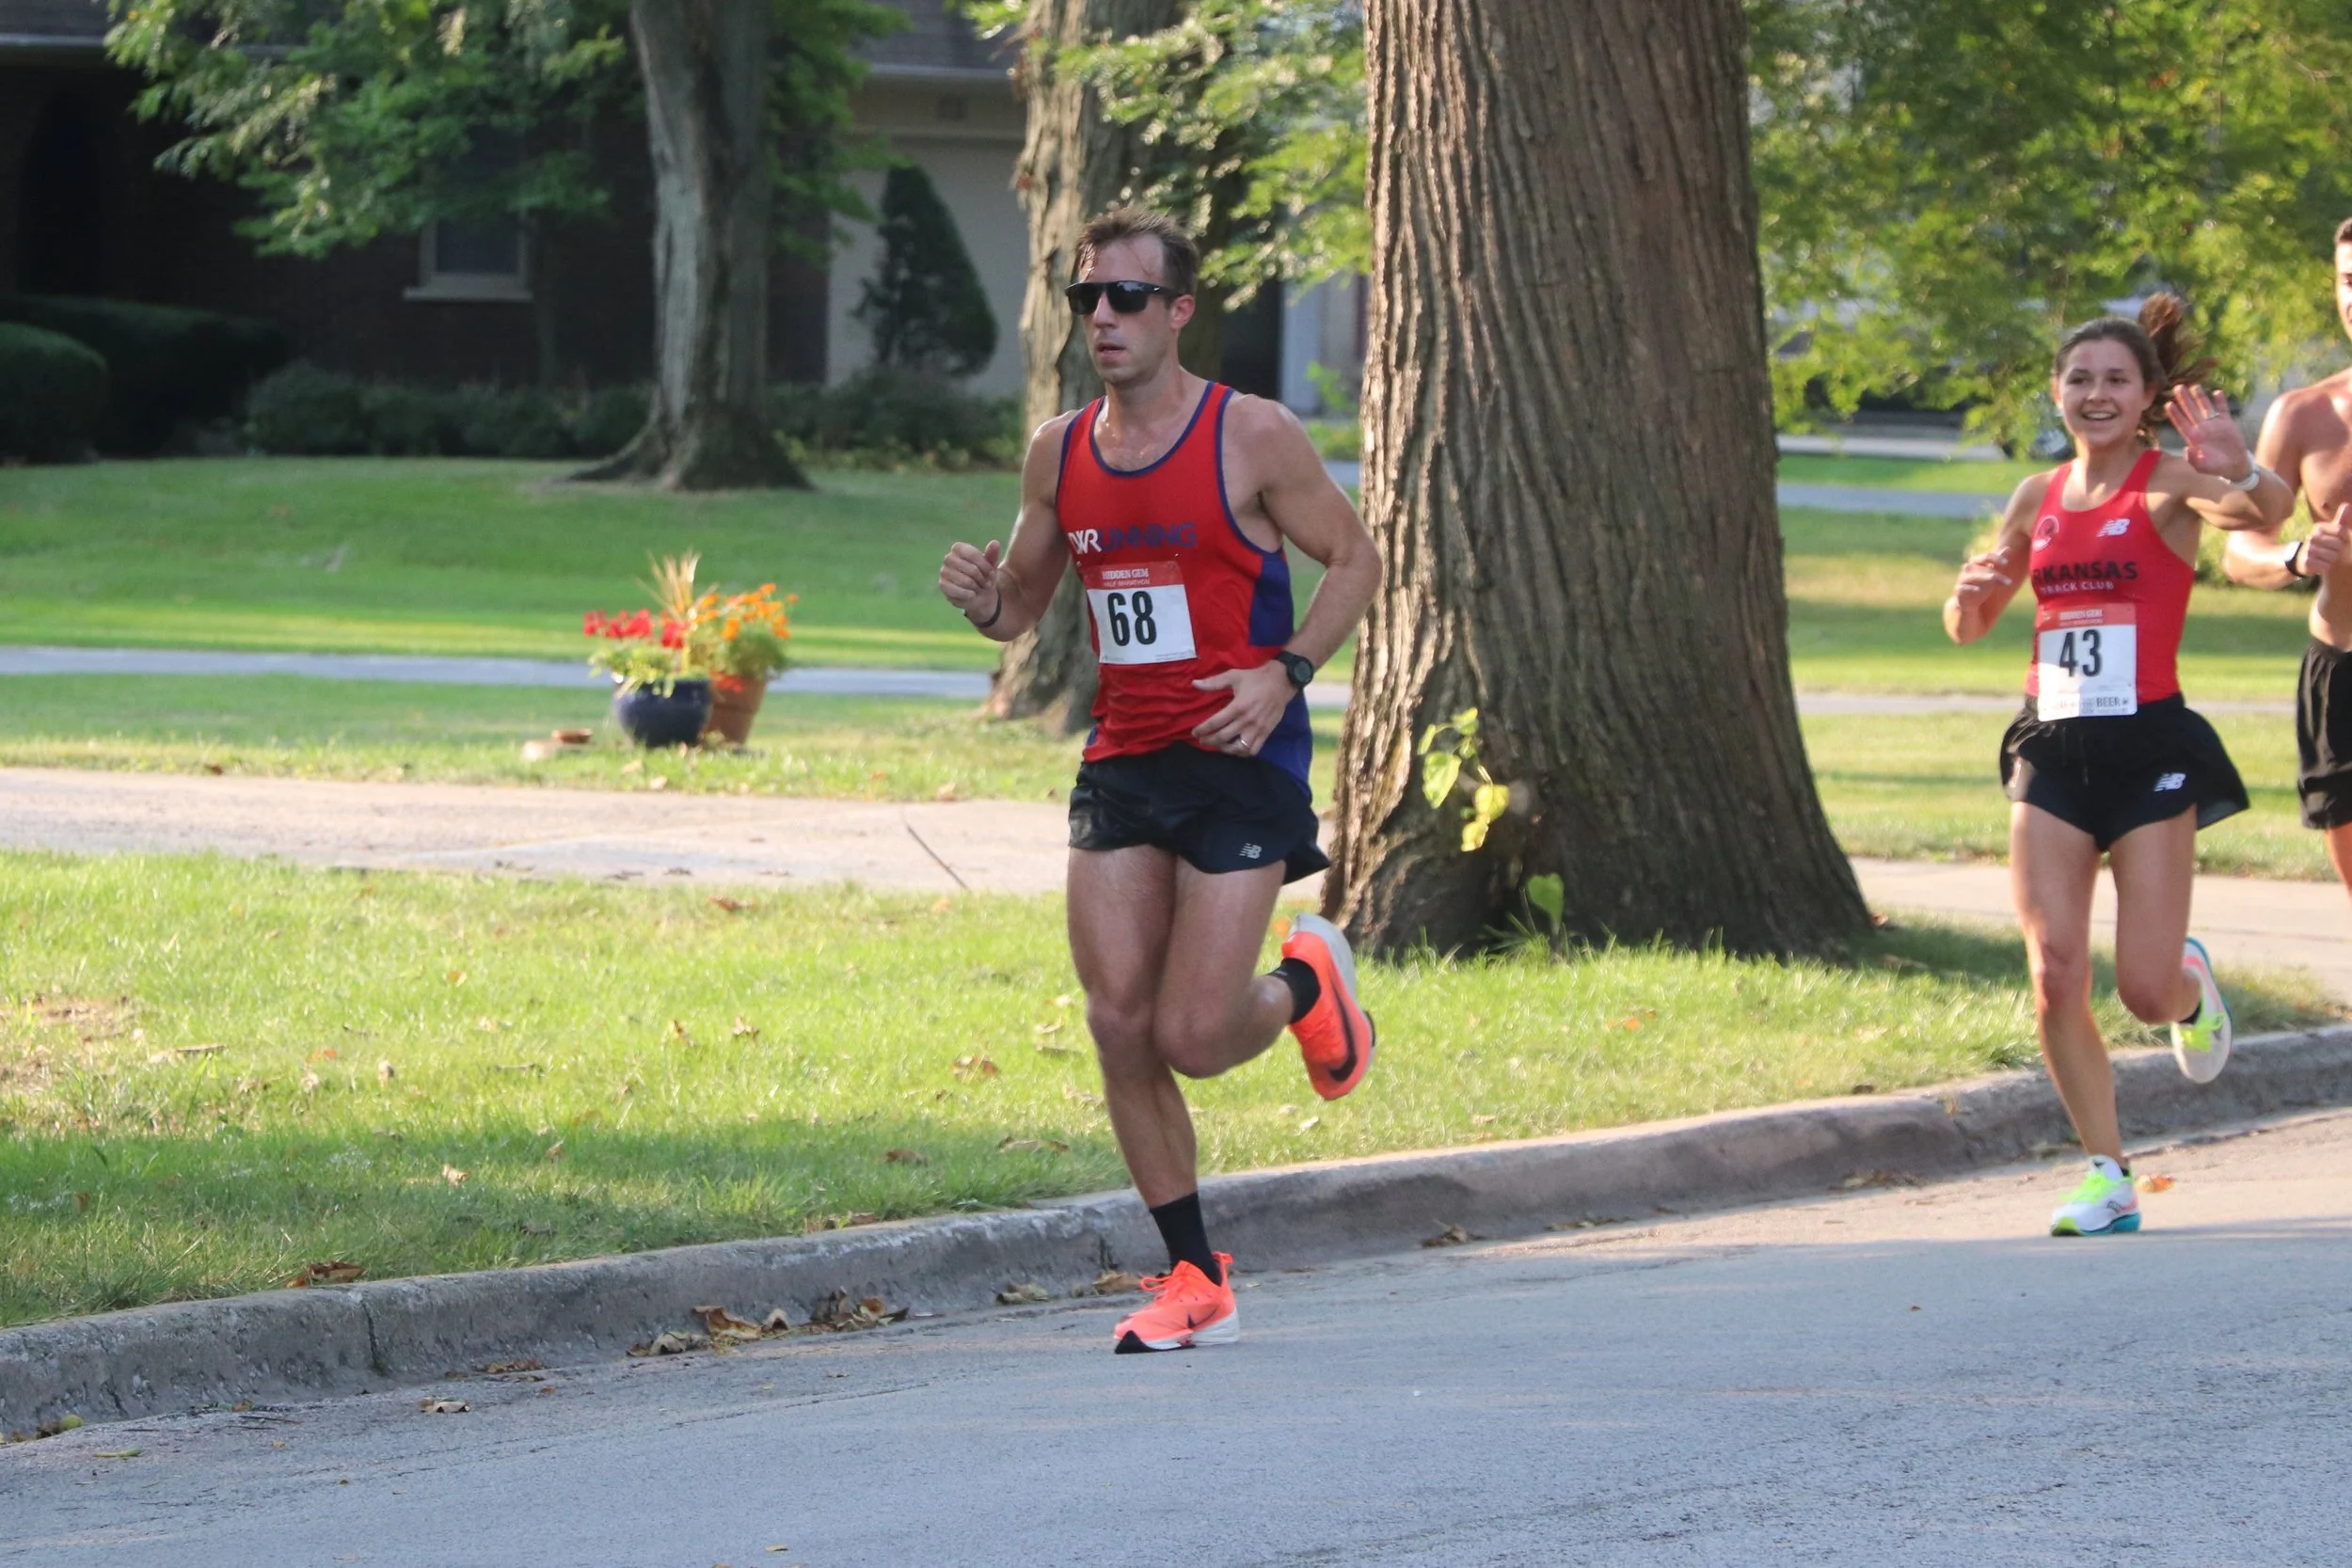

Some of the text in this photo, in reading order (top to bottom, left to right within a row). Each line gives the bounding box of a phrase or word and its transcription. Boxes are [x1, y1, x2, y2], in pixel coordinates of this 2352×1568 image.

[2032, 561, 2138, 583] RKANSAS
[2040, 580, 2115, 594] TRACK CLUB
[1107, 591, 1157, 646] 68
[2059, 629, 2103, 677] 43
[2095, 696, 2121, 708] BEER
